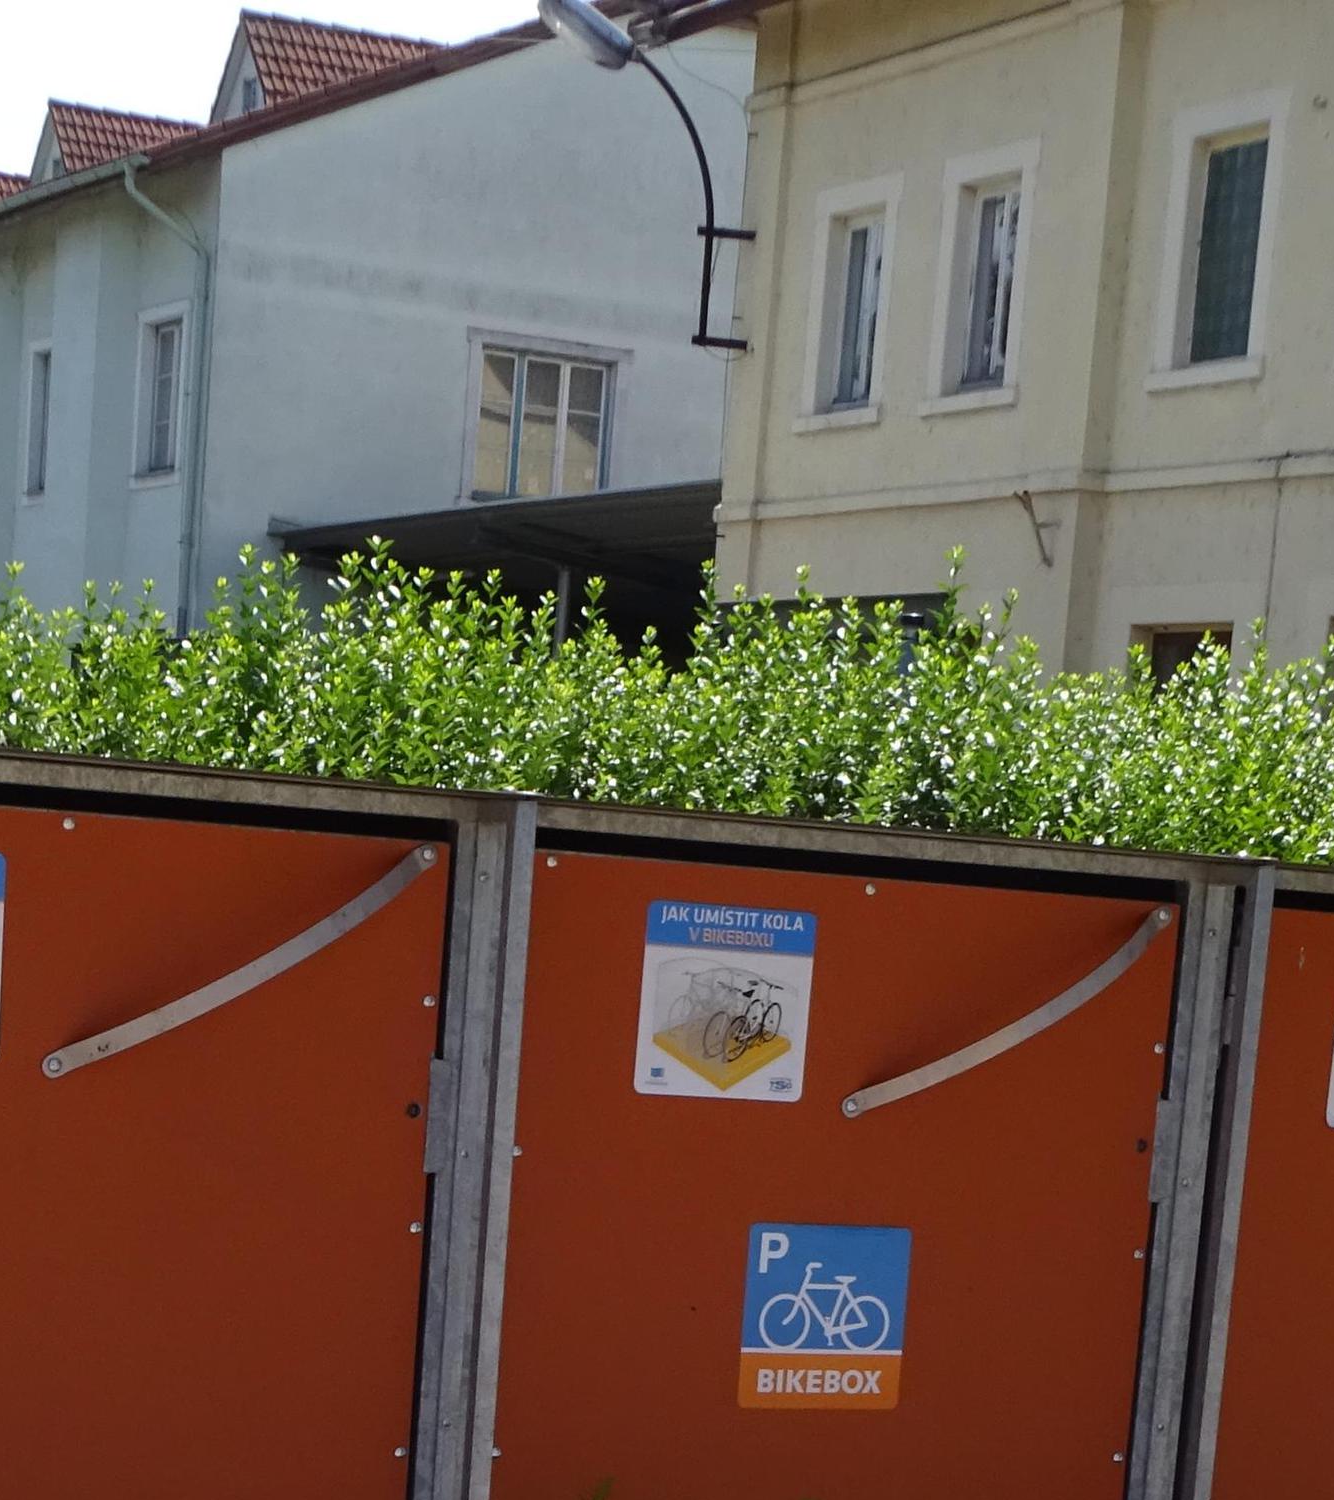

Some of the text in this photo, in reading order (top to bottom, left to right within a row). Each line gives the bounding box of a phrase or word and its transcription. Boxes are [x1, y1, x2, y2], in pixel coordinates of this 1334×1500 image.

[661, 905, 804, 932] JAK UMÍSTIT KOLA
[688, 927, 775, 947] V BIKEBOXU
[758, 1232, 790, 1274] P
[756, 1368, 882, 1394] BIKEBOX
